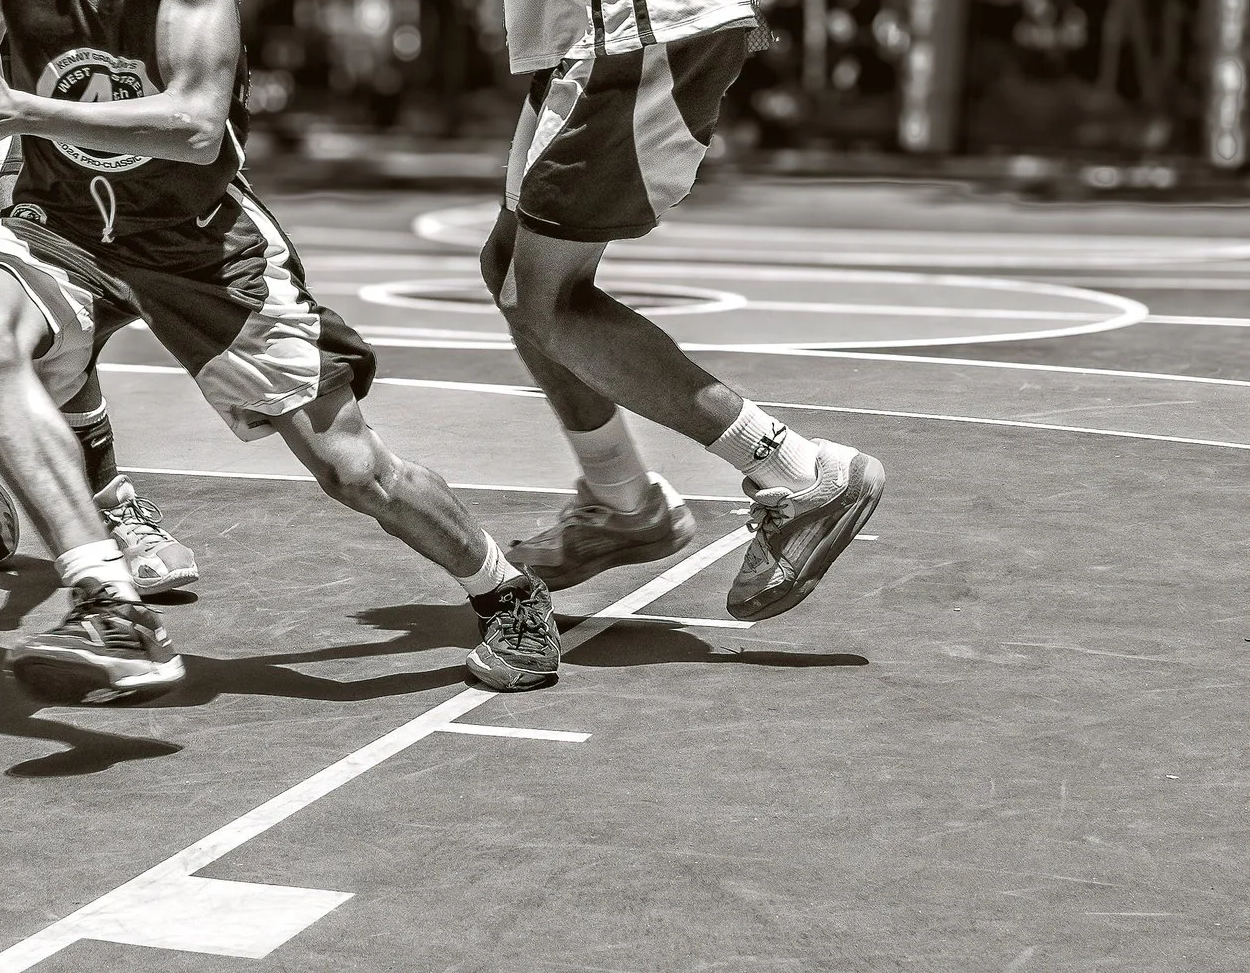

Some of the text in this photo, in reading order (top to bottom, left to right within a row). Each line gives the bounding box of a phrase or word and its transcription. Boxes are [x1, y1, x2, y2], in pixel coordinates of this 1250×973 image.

[56, 51, 91, 70] KENNY
[57, 66, 91, 94] WEST
[111, 73, 144, 99] STREE
[80, 154, 142, 169] PRO-CLASSIC
